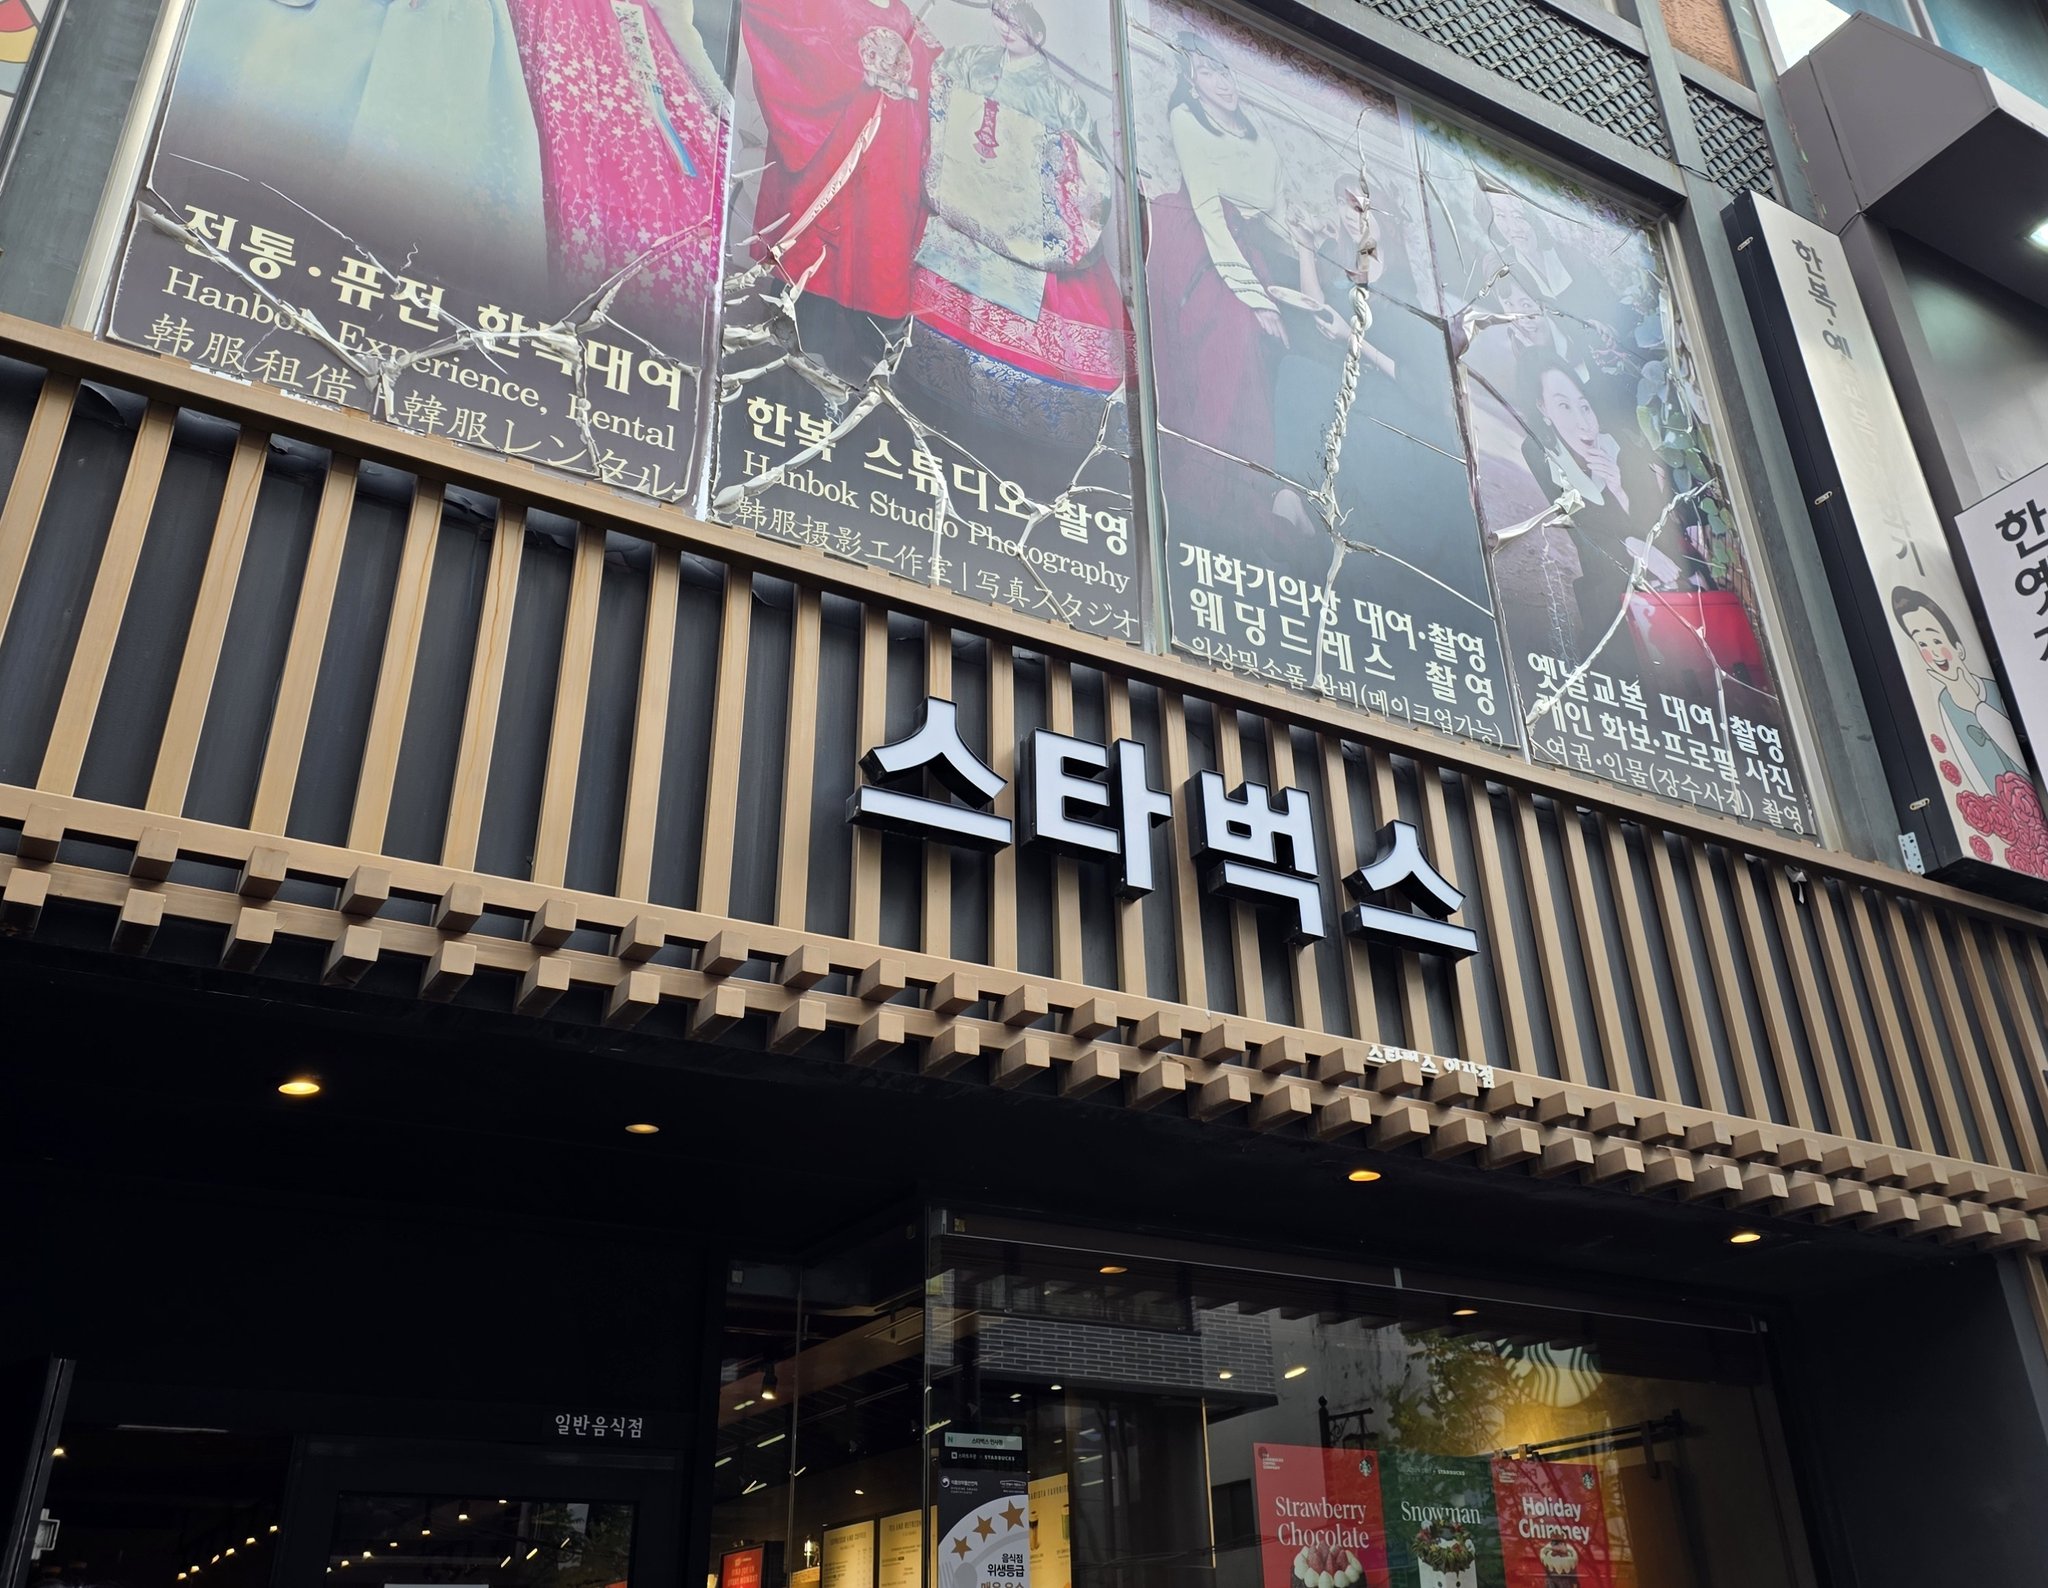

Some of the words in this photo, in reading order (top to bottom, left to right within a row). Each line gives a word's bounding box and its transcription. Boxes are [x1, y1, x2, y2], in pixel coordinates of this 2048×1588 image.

[184, 204, 446, 333] 전통·퓨전
[143, 312, 357, 405] 韩服租借
[398, 389, 677, 497] 韓服レンタル
[746, 395, 837, 463] 한복
[863, 437, 1033, 521] 스튜디오
[1053, 498, 1128, 556] 촬영
[869, 489, 959, 539] Studo
[967, 520, 1131, 595] Photography
[1179, 542, 1342, 627] 개화기의상
[1353, 597, 1487, 674] 대여·촬영
[1425, 660, 1497, 716] 촬영
[1527, 652, 1648, 721] 옛날교복
[1658, 693, 1785, 764] 대여·촬영
[1599, 712, 1740, 786] 화보·프로필
[1745, 756, 1797, 803] 사진
[848, 694, 1480, 958] 스타벅스
[1761, 797, 1805, 835] 촬영
[555, 1413, 643, 1438] 일반음식점
[1275, 1496, 1367, 1525] Strawberry
[1278, 1521, 1370, 1549] Chocolate
[1401, 1500, 1482, 1525] Snowman
[1518, 1518, 1590, 1545] Chimney
[1521, 1496, 1581, 1523] Holiday
[987, 1563, 1025, 1577] 위생등급
[1001, 1553, 1024, 1564] 음식점
